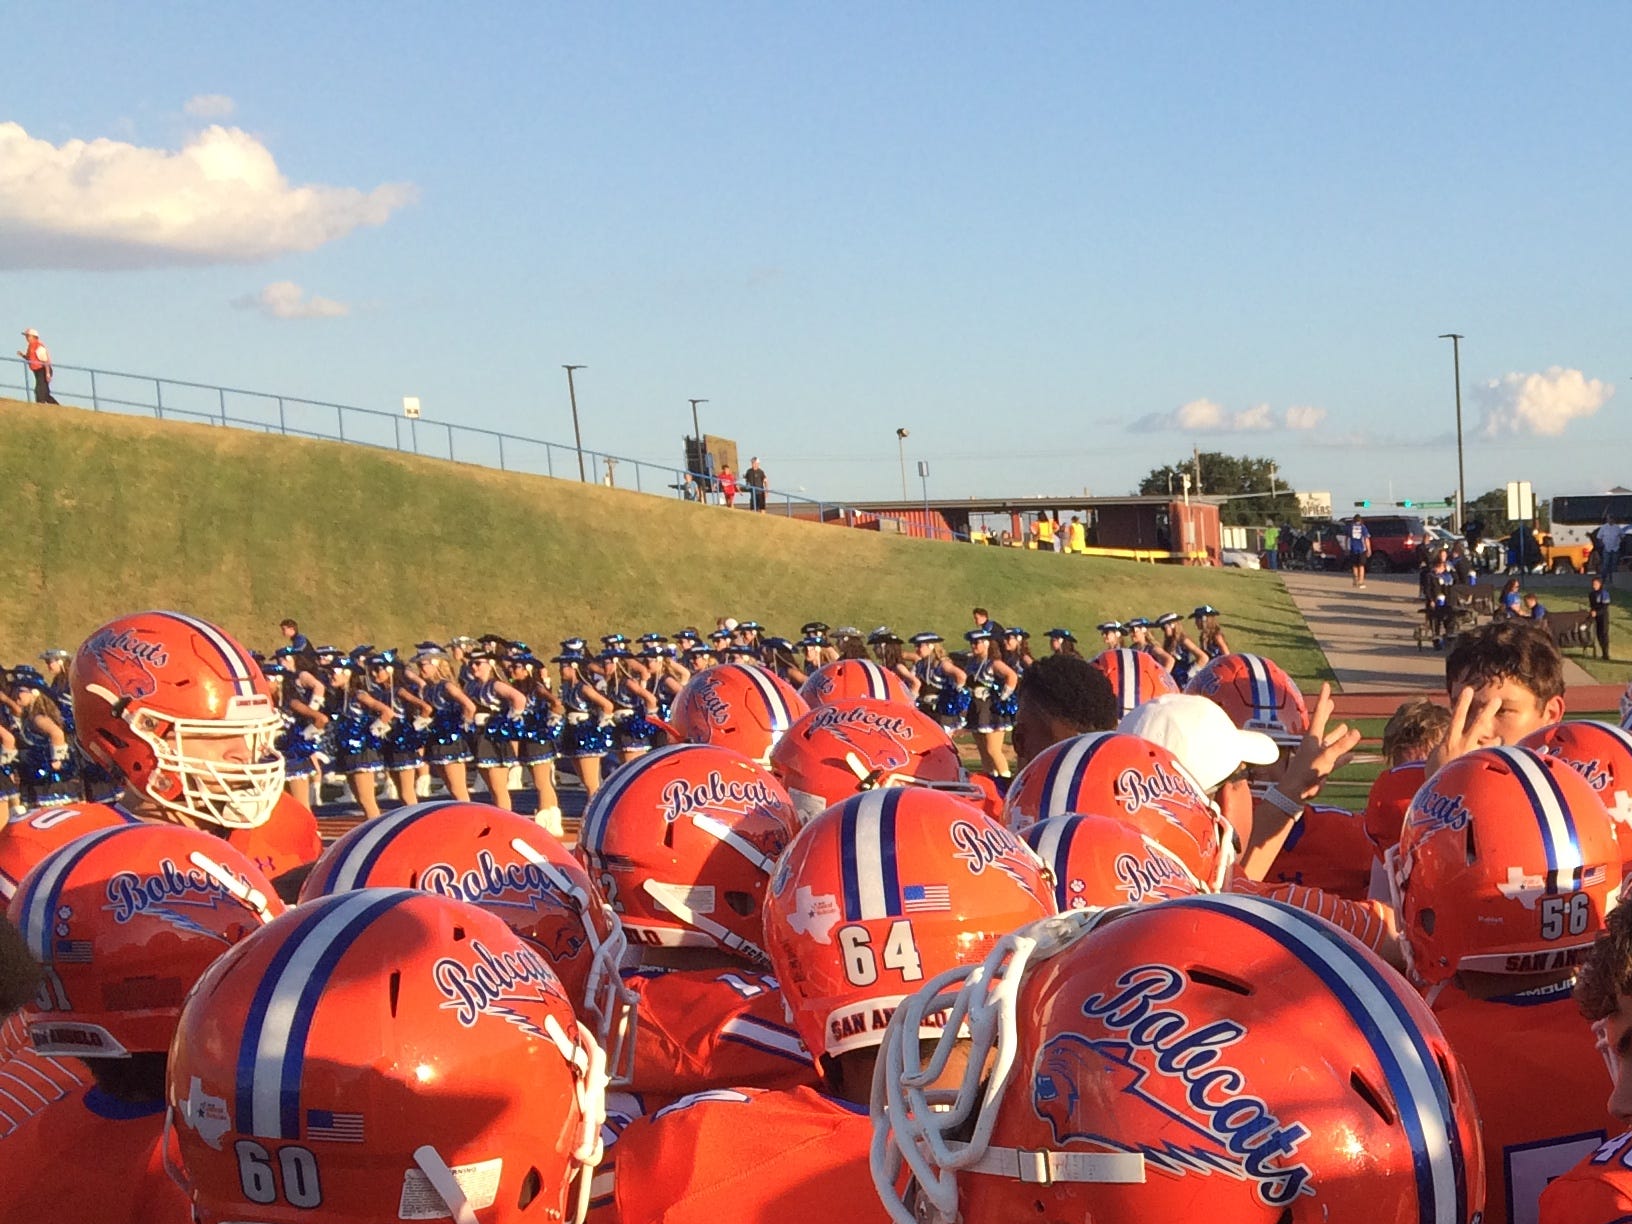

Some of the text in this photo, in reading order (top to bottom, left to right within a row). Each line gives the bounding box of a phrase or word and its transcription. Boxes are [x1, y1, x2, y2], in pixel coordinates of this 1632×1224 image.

[1301, 505, 1332, 515] OPIERS
[812, 706, 914, 741] Bobcats
[660, 771, 785, 825] Bobcats
[1541, 892, 1590, 941] 56
[837, 918, 924, 988] 64
[831, 1012, 867, 1042] SAN
[1080, 963, 1318, 1208] Bobcats
[234, 1139, 323, 1210] 60
